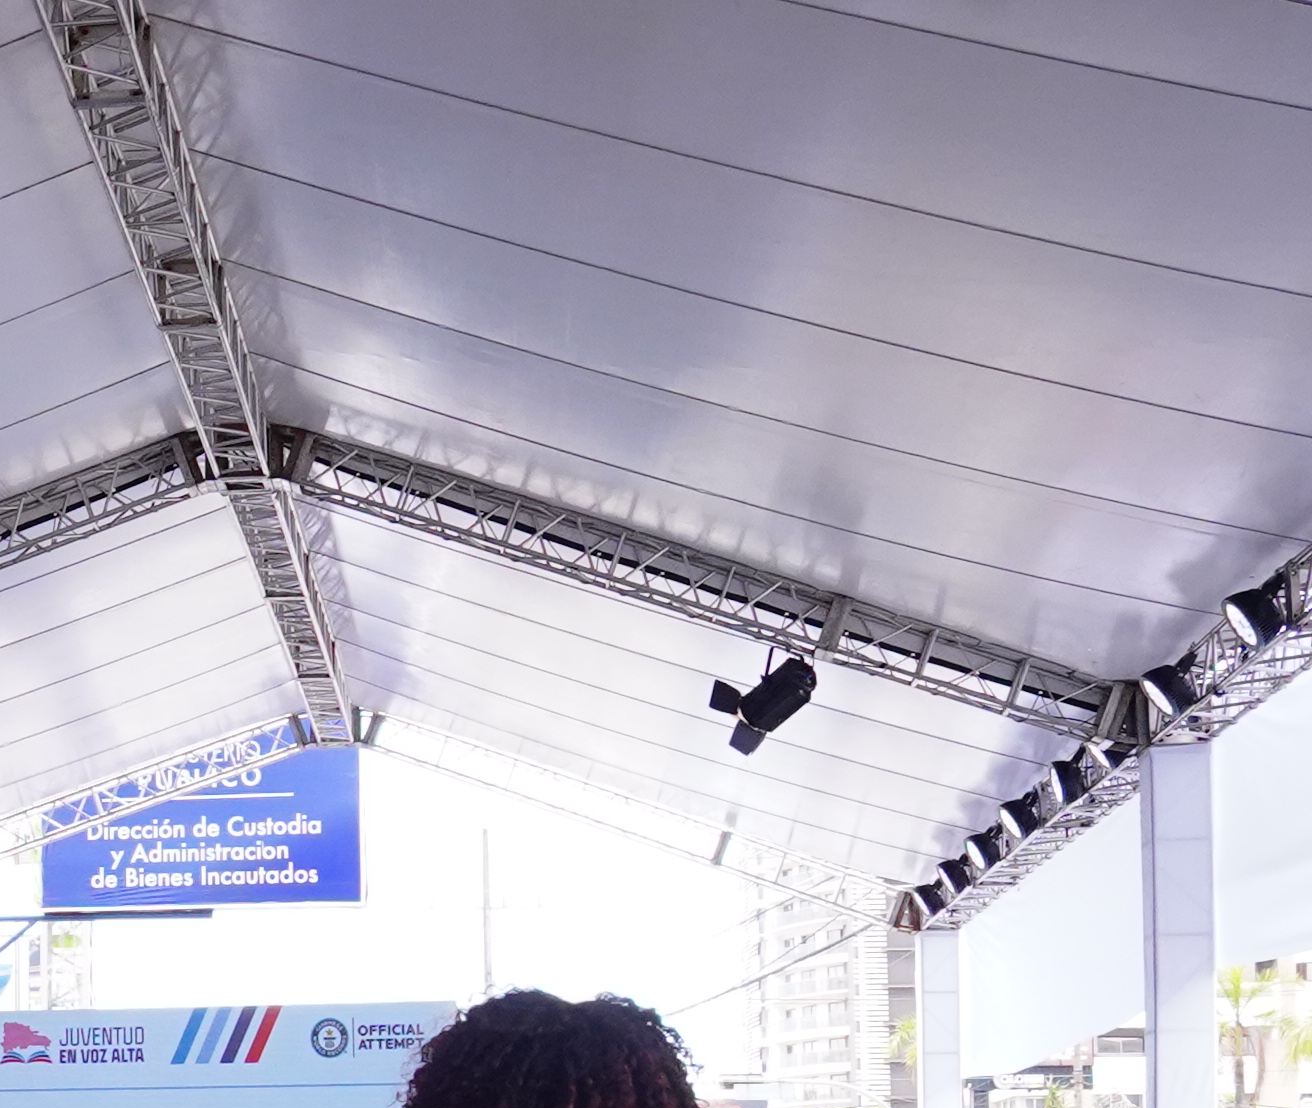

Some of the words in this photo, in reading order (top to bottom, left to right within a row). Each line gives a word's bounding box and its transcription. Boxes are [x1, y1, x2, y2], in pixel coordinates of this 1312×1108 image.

[87, 819, 186, 841] Dirección
[193, 816, 221, 838] de
[227, 813, 322, 837] Custodia
[111, 851, 124, 870] y
[91, 868, 118, 889] de
[126, 865, 194, 888] Bienes
[201, 862, 319, 886] Incautados
[59, 1026, 145, 1046] JUVENTUD
[357, 1023, 425, 1037] OFFICIAL
[358, 1037, 426, 1051] ATTEMPT
[59, 1049, 79, 1064] EN
[80, 1049, 108, 1064] VOZ
[111, 1047, 145, 1063] ALTA
